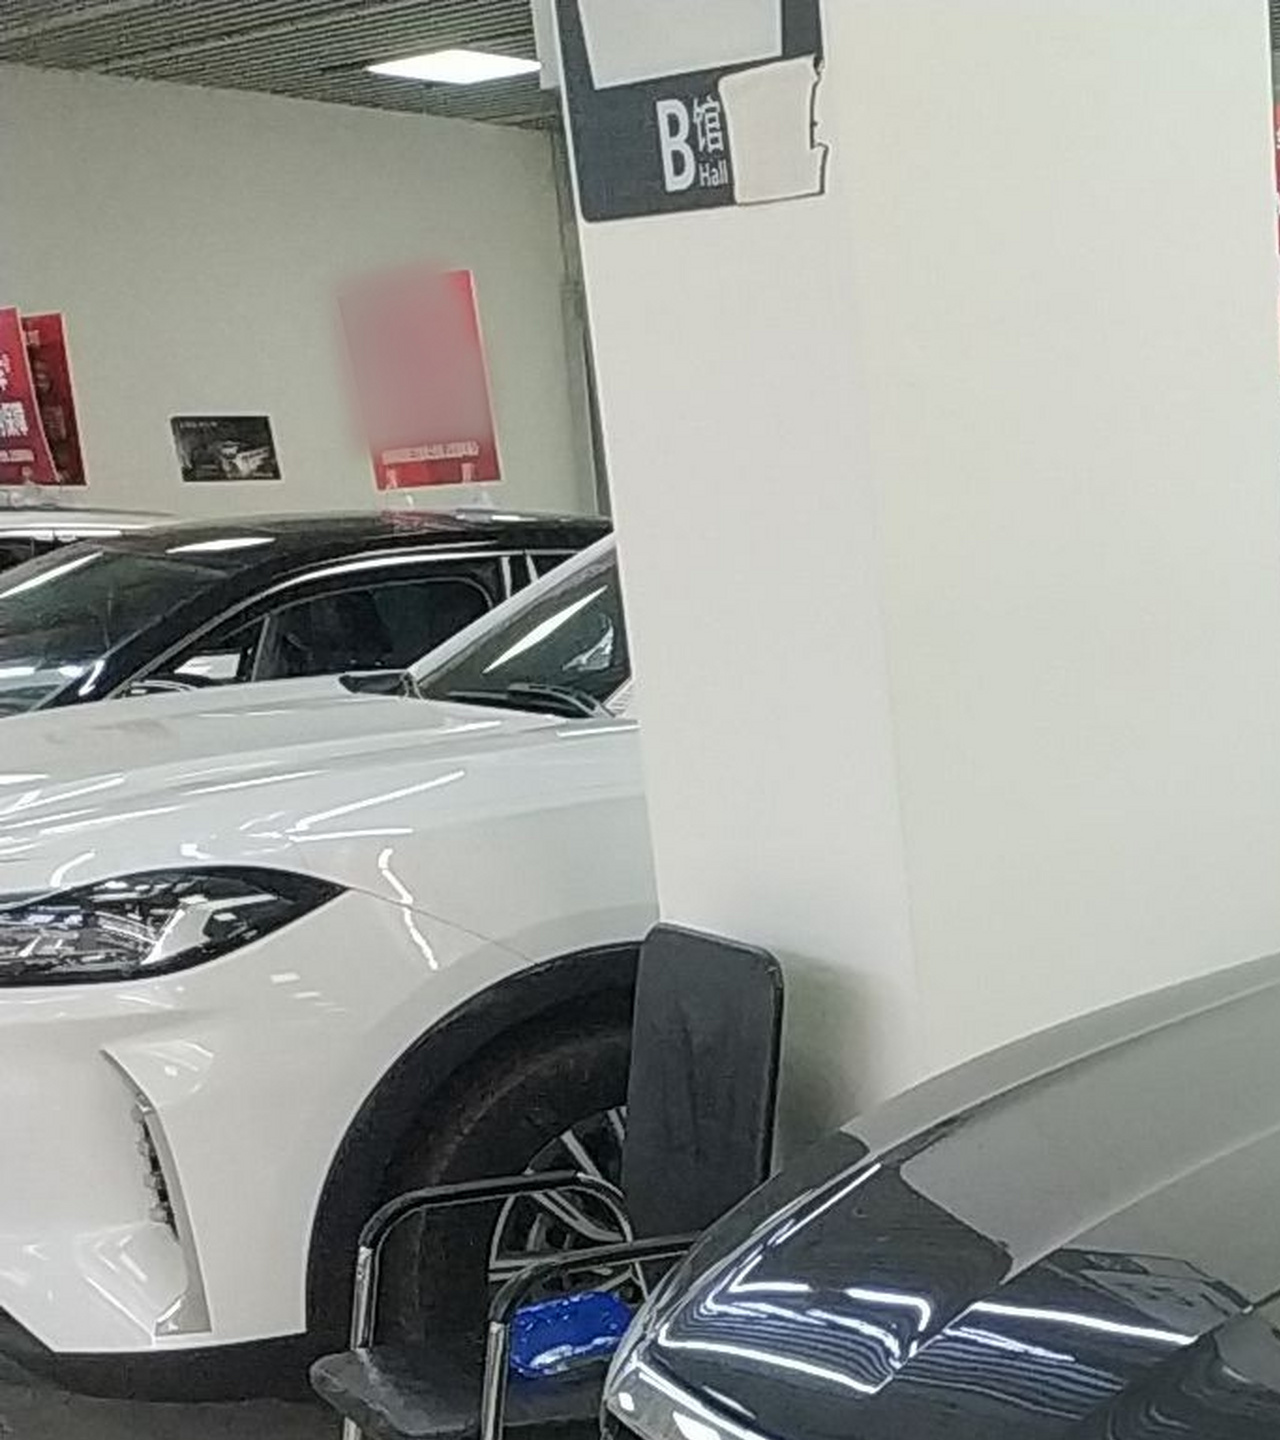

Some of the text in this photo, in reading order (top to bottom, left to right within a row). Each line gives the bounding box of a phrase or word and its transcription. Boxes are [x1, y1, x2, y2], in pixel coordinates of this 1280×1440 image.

[656, 93, 724, 192] B 馆
[699, 159, 729, 187] Hall
